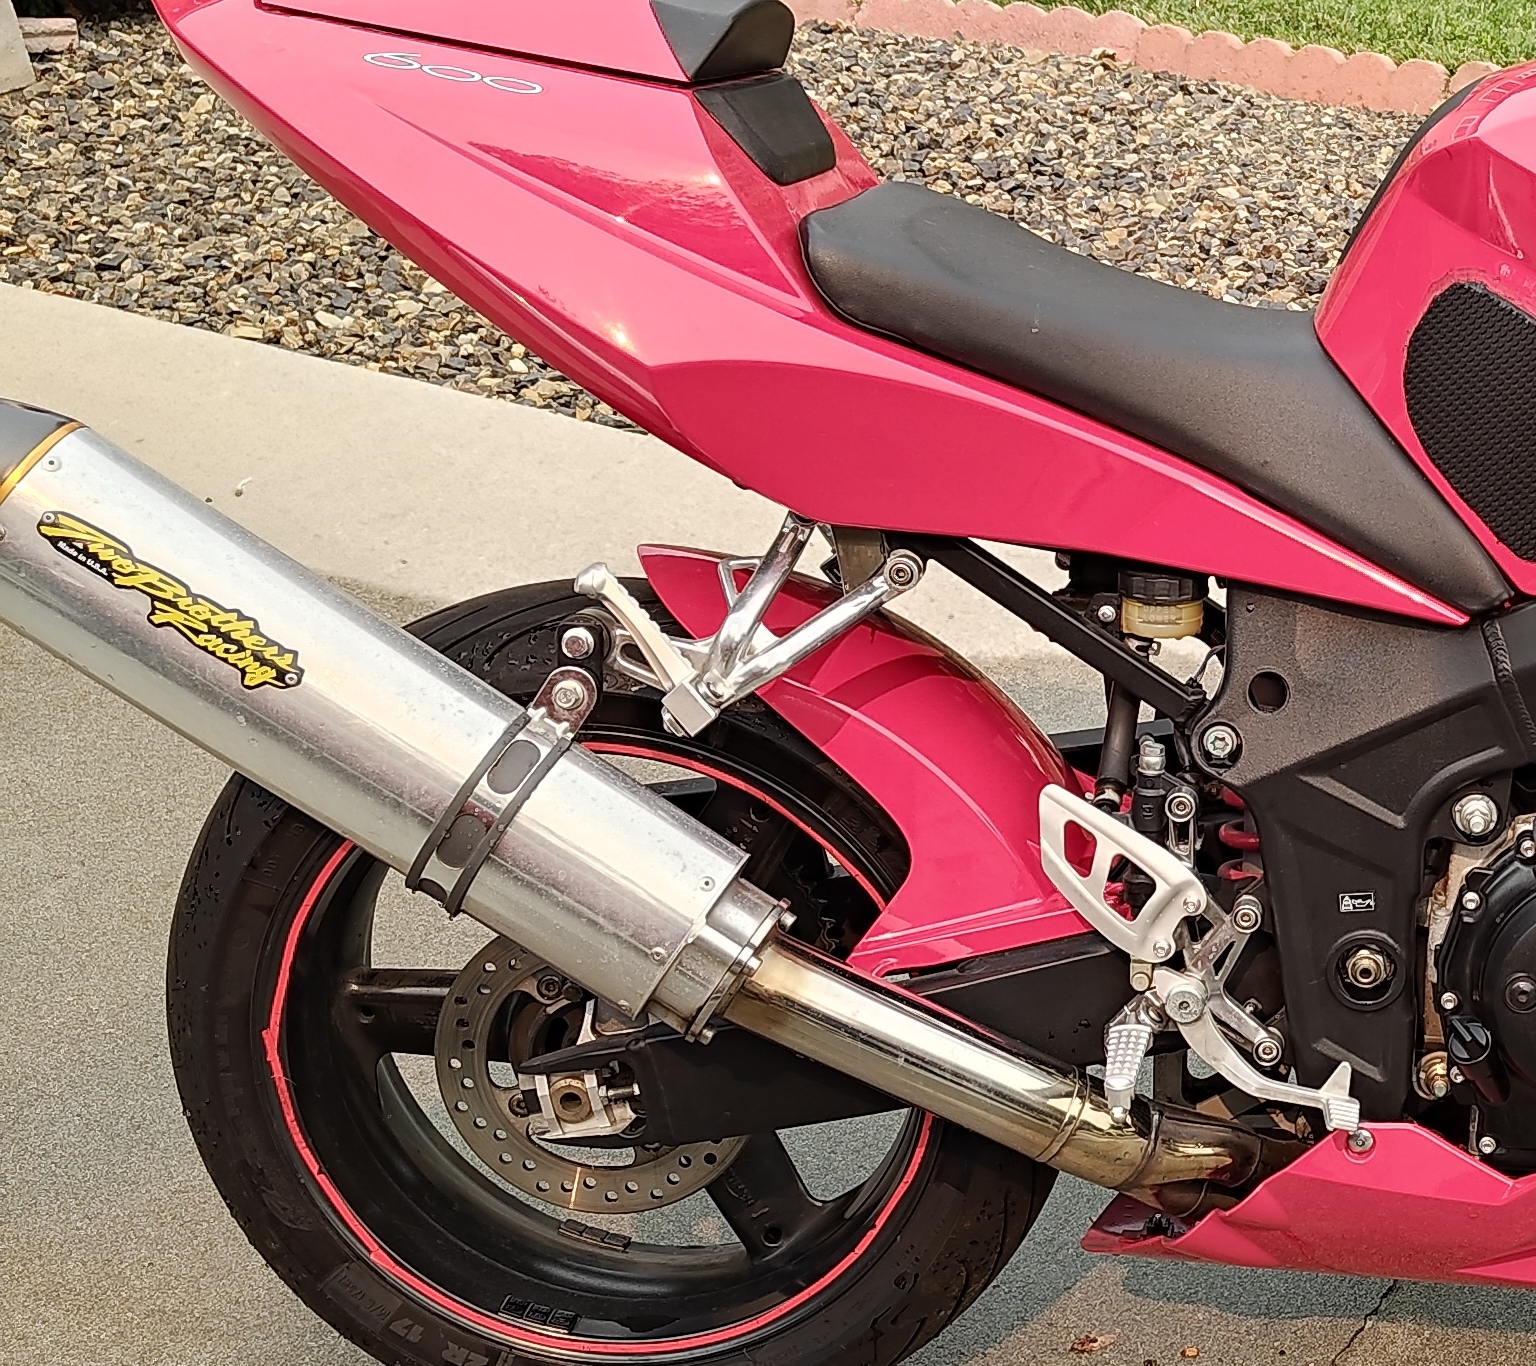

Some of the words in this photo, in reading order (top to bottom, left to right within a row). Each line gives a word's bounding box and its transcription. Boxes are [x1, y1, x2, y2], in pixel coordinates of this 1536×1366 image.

[363, 52, 543, 95] 600
[149, 600, 288, 687] Racing
[388, 1317, 426, 1346] 17
